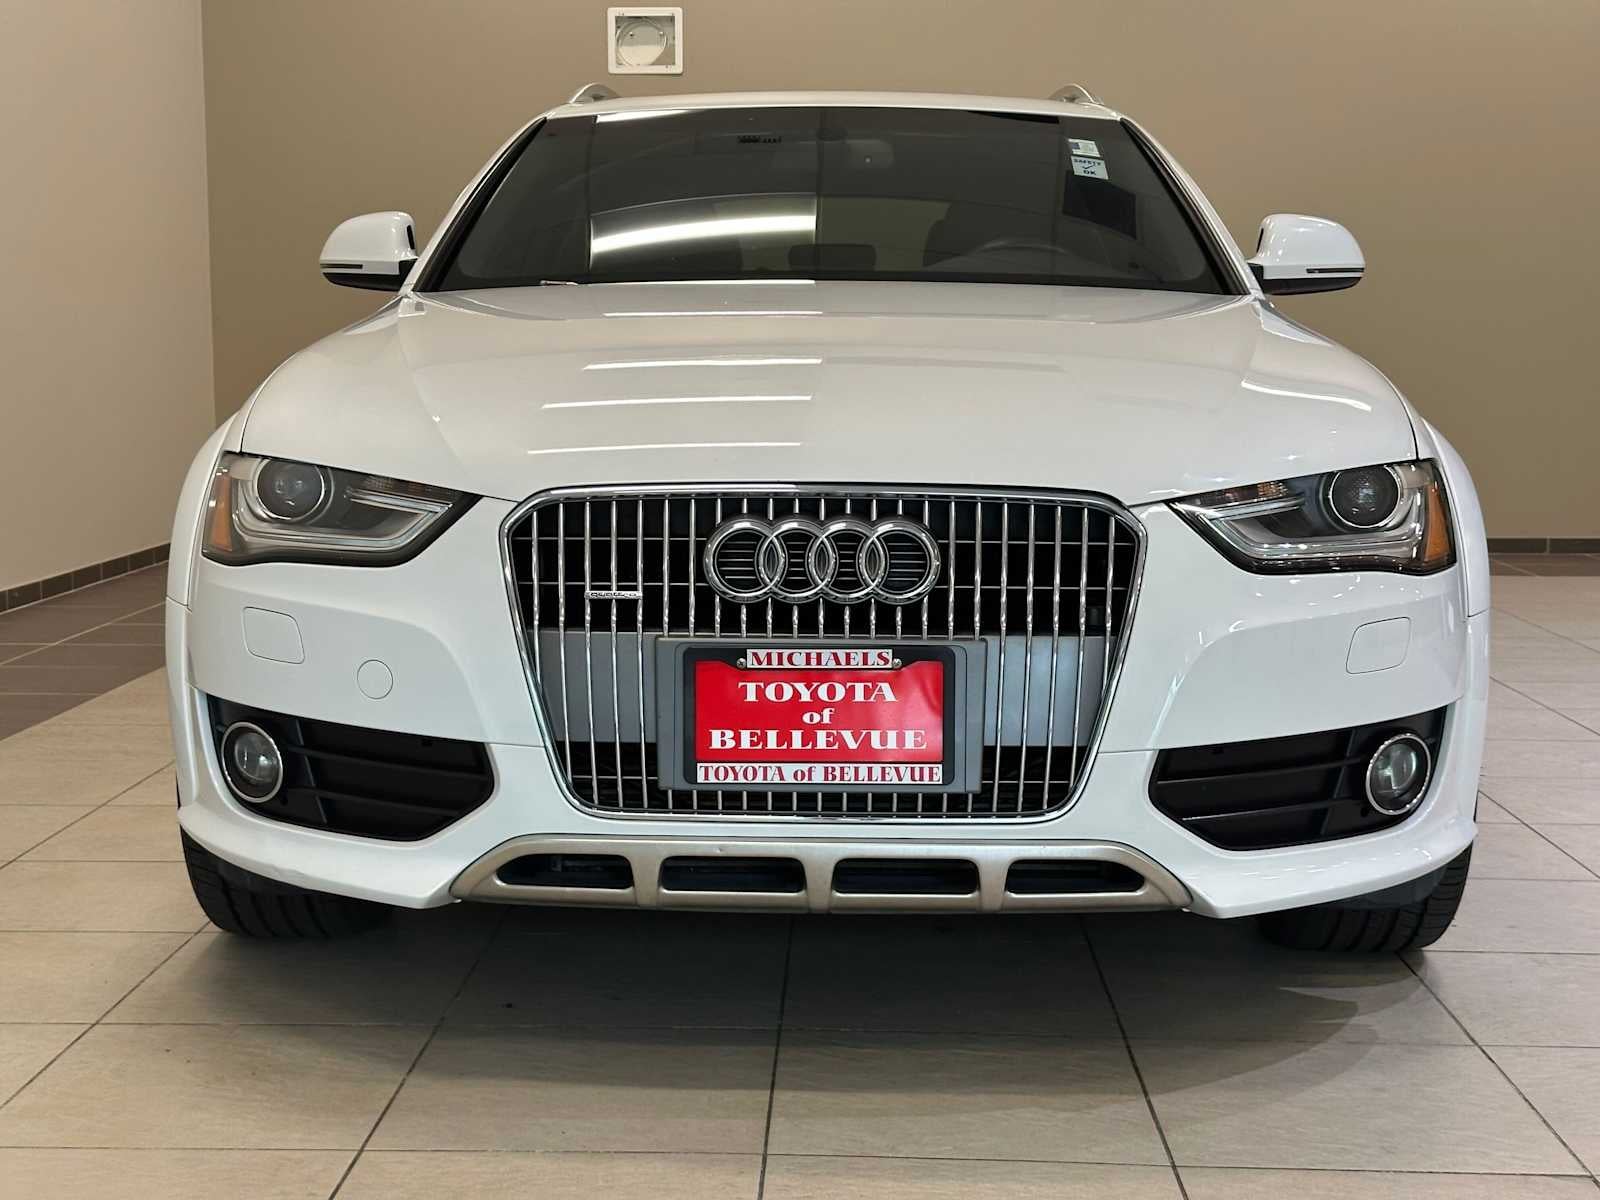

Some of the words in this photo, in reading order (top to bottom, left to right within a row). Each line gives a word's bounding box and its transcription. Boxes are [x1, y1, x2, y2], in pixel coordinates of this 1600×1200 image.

[750, 651, 890, 667] MICHAELS
[738, 682, 897, 702] TOYOTA
[802, 708, 835, 724] of
[709, 730, 927, 749] BELLEVUE
[700, 765, 785, 781] TOYOTA
[793, 765, 817, 781] of
[823, 765, 941, 782] BELLEVUE
